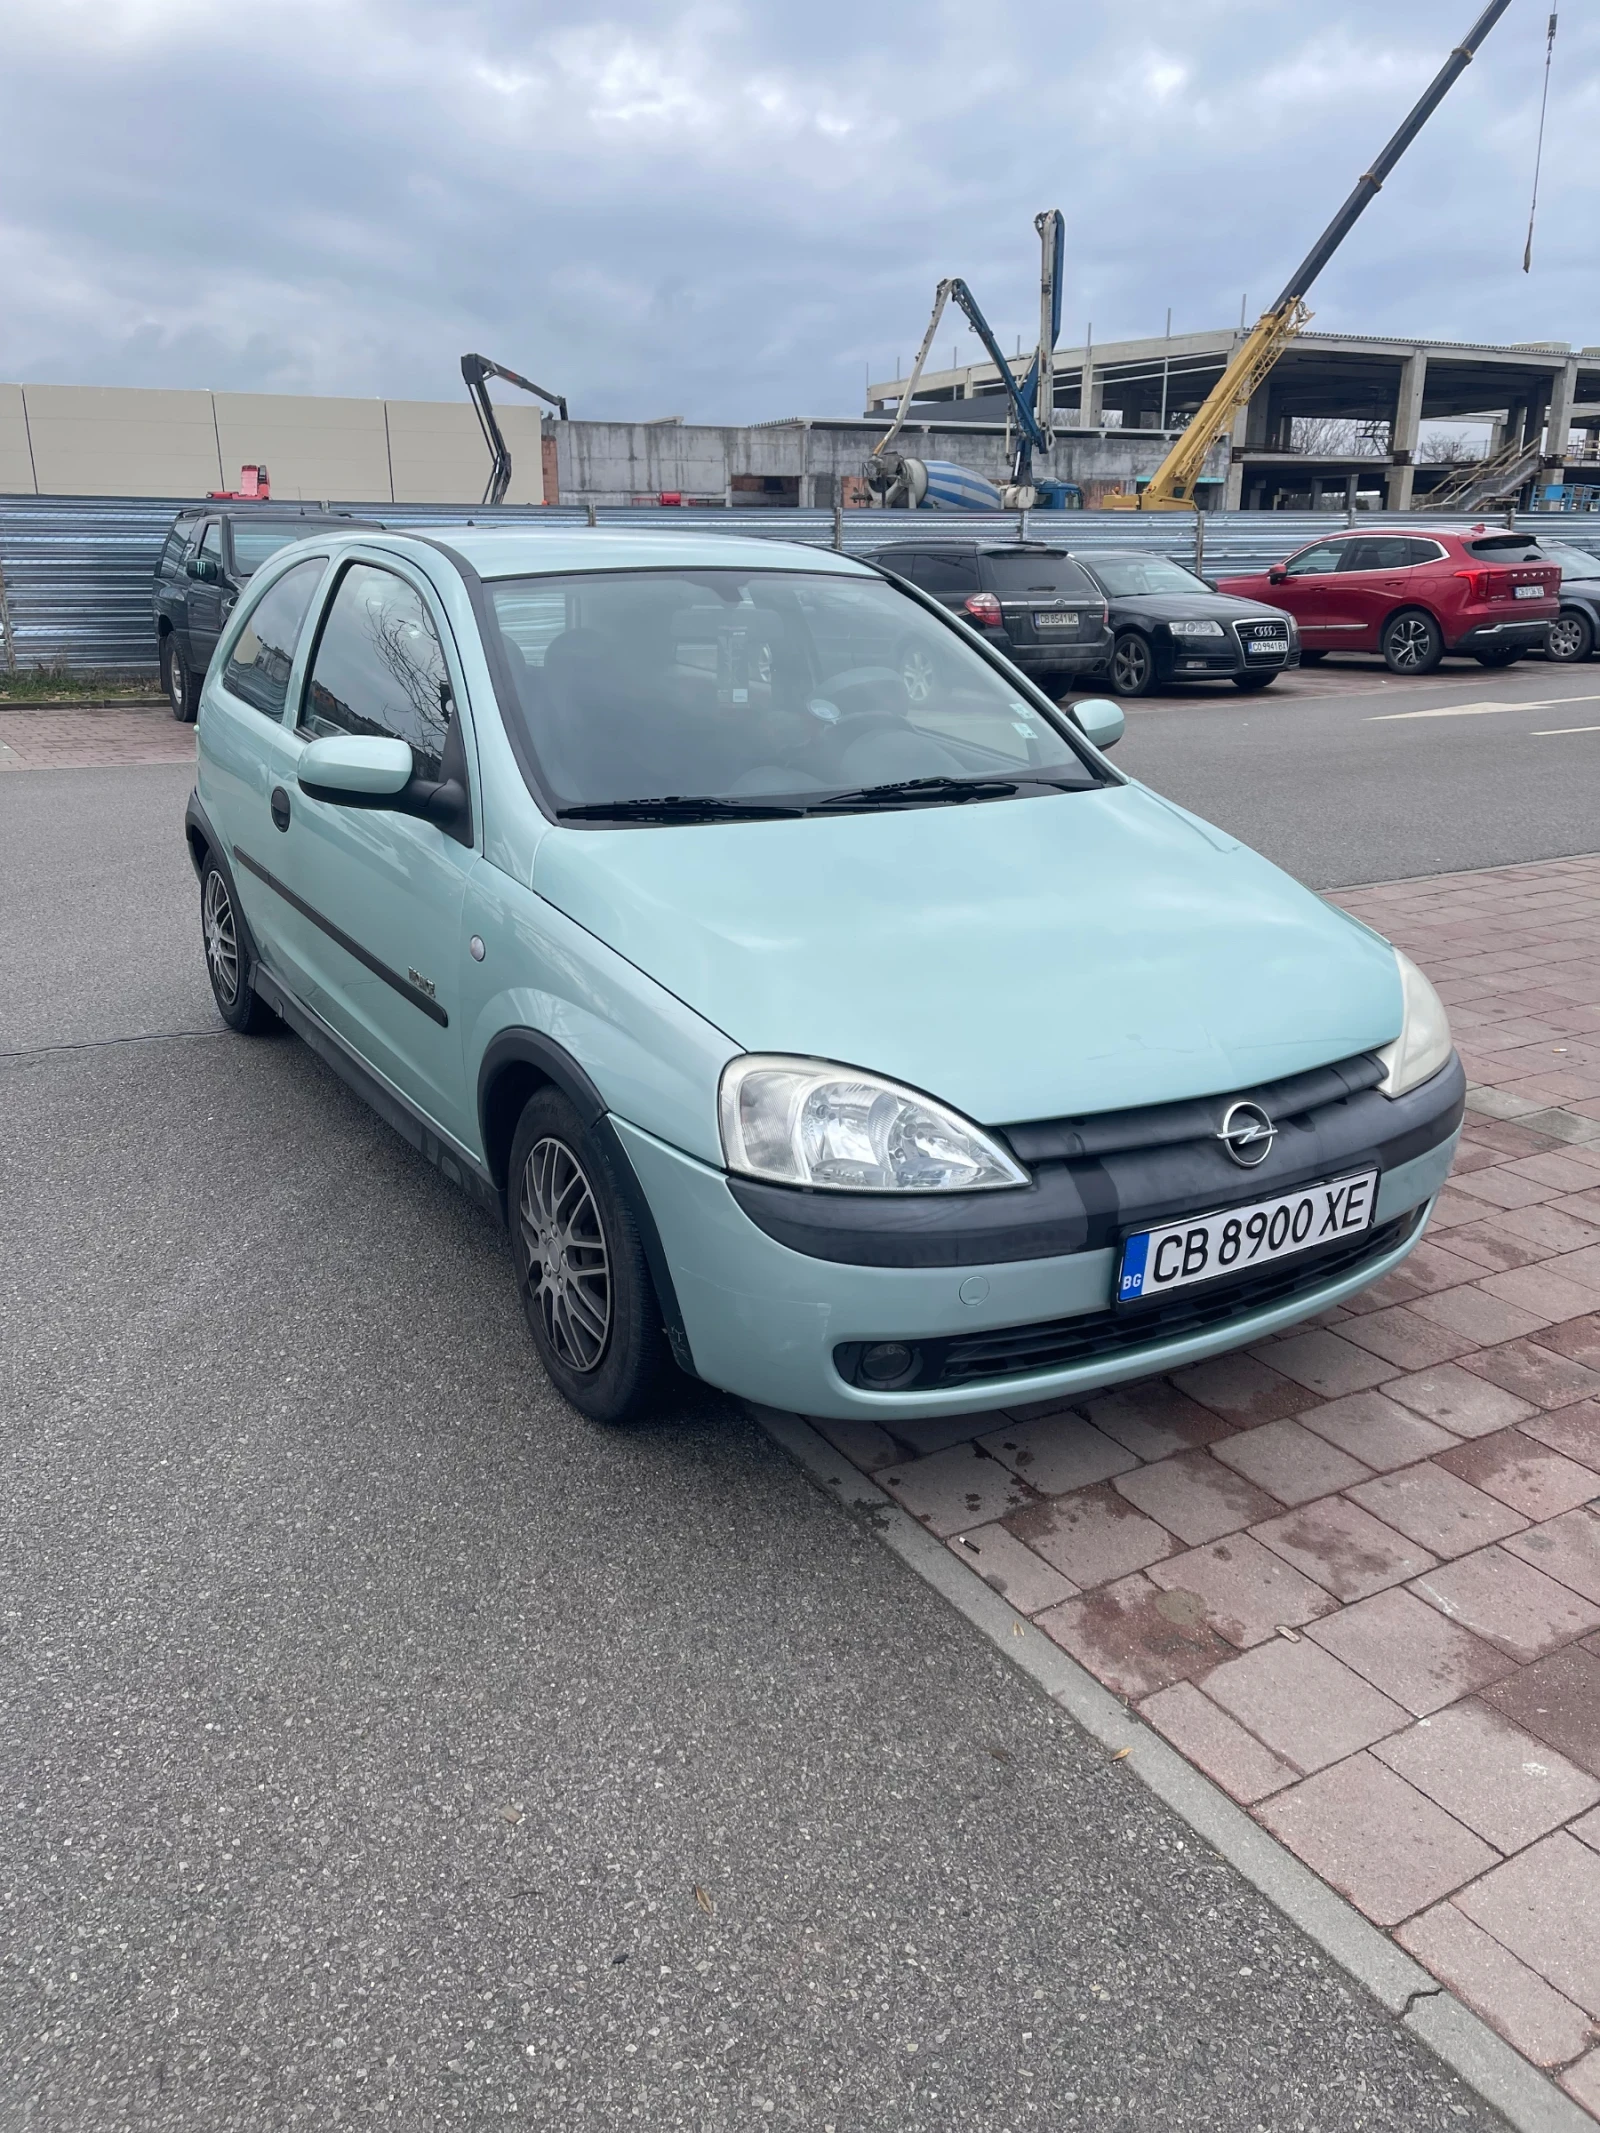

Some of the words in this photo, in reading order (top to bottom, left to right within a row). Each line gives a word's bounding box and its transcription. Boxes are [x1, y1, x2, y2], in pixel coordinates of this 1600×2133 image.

[1040, 614, 1050, 624] CB
[1050, 614, 1068, 624] 8541
[1068, 613, 1078, 623] MC
[1253, 643, 1262, 651] CO
[1262, 642, 1278, 651] 9941
[1122, 1273, 1142, 1291] BG
[1153, 1227, 1210, 1283] CB
[1218, 1198, 1314, 1266] 8900
[1318, 1180, 1369, 1237] XE
